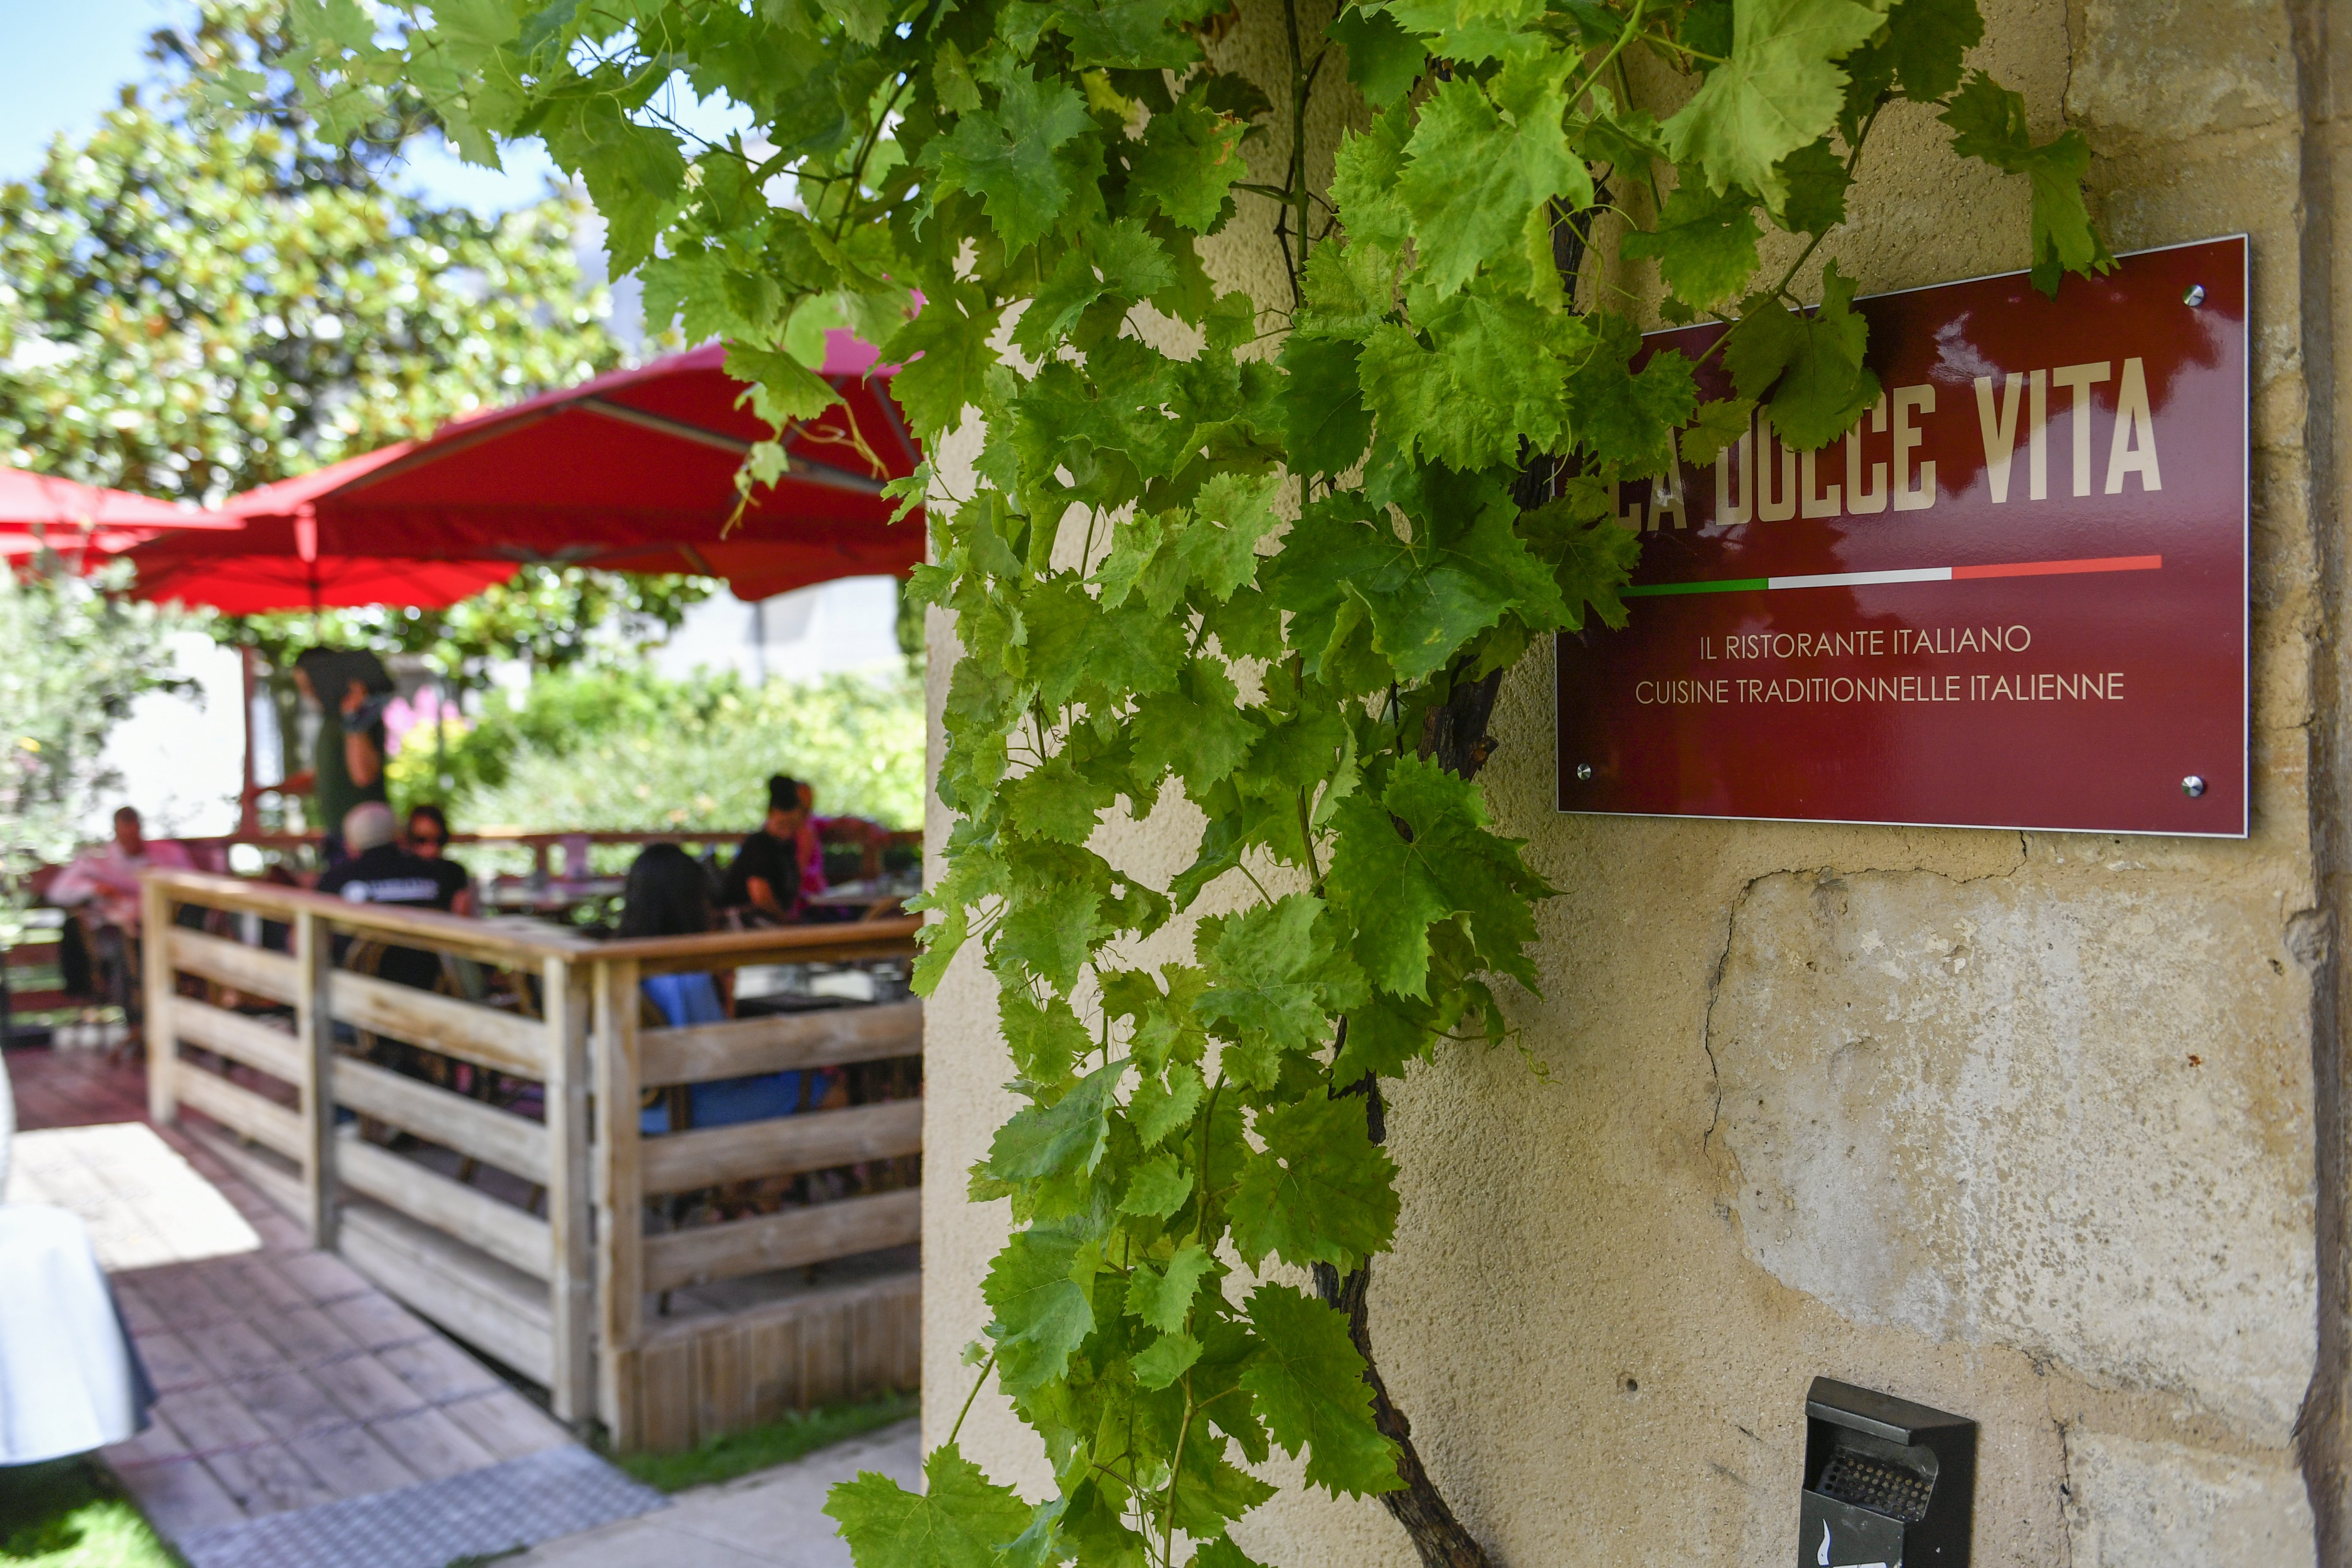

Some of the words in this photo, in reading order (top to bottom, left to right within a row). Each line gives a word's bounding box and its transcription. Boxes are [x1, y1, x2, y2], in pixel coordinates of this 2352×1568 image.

[1715, 384, 1936, 525] DOLCE
[1974, 357, 2162, 504] VITA
[1701, 636, 1717, 660] IL
[1726, 630, 1884, 659] RISTORANTE
[1894, 625, 2031, 655] ITALIANO
[1636, 680, 1729, 704] CUISINE
[1736, 675, 1960, 702] TRADITIONNELLE
[1971, 672, 2124, 701] ITALIENNE
